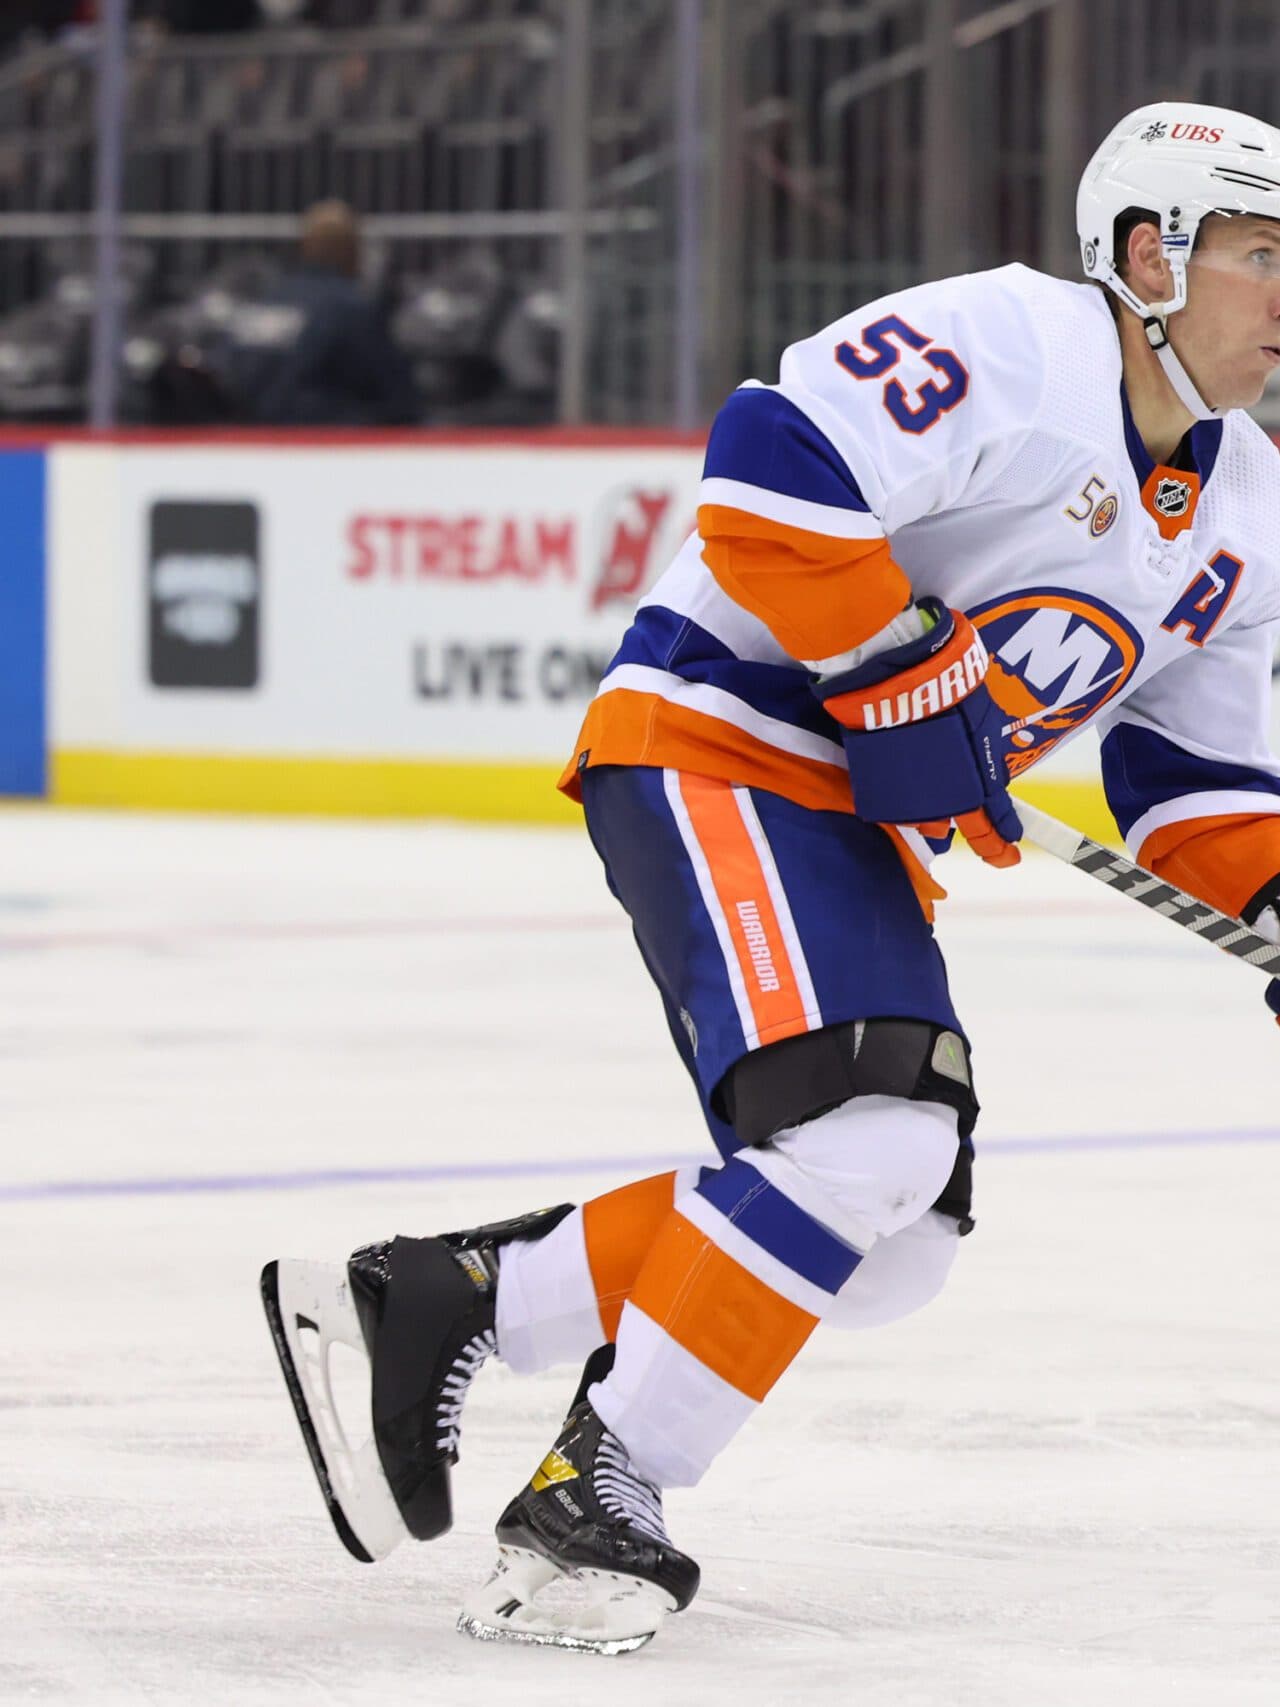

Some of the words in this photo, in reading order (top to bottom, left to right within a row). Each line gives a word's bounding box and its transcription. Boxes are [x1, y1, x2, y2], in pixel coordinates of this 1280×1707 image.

[1170, 123, 1225, 143] UBS
[834, 313, 970, 436] 53
[348, 514, 578, 581] STREAM
[1159, 548, 1245, 648] A
[412, 644, 521, 702] LIVE
[736, 900, 781, 993] WARRIOR
